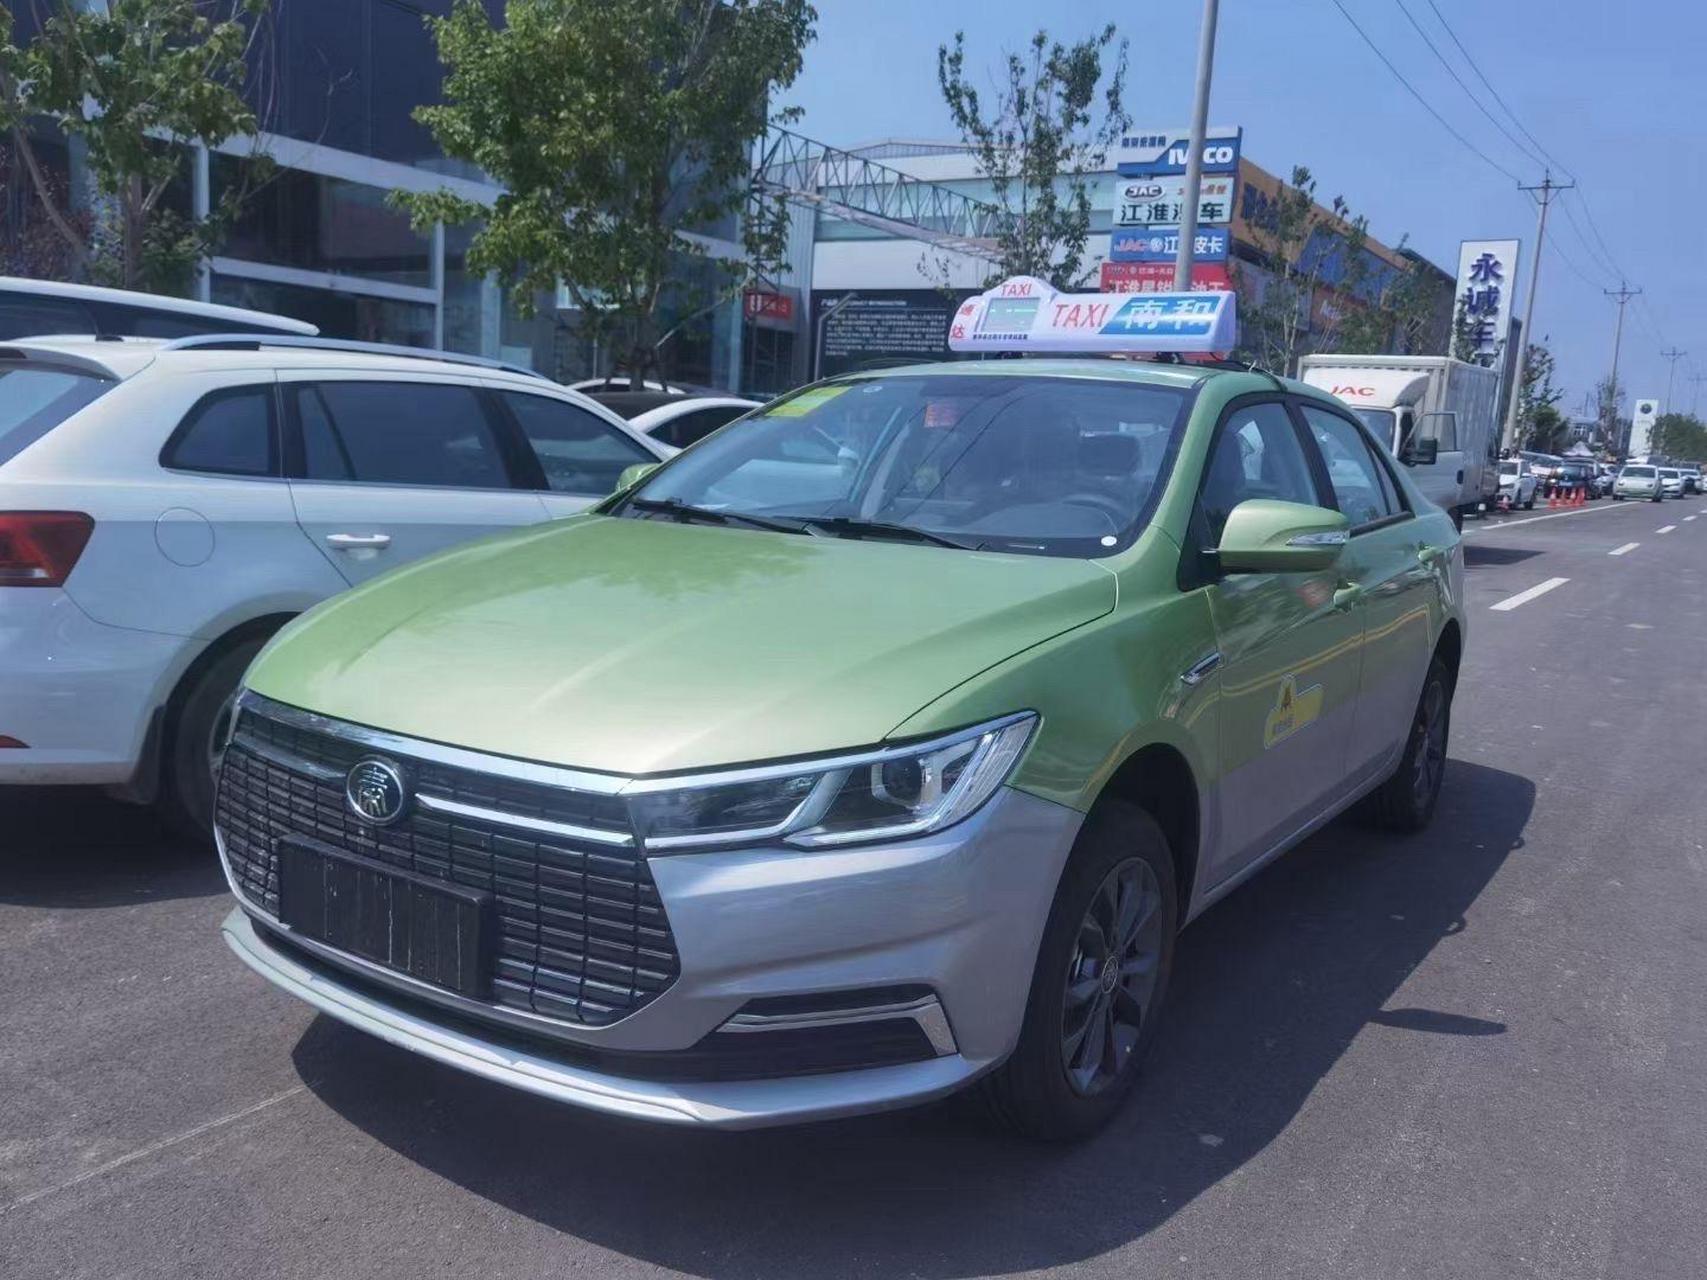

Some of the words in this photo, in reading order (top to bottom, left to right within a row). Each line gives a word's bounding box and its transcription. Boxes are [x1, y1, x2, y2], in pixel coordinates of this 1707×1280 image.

[1168, 147, 1233, 165] IVCO
[1128, 185, 1163, 198] JAC
[1163, 236, 1224, 254] 江皮卡
[1002, 283, 1033, 297] TAXI
[1052, 304, 1110, 328] TAXI
[1125, 299, 1211, 330] 南和
[1331, 385, 1376, 397] JAC
